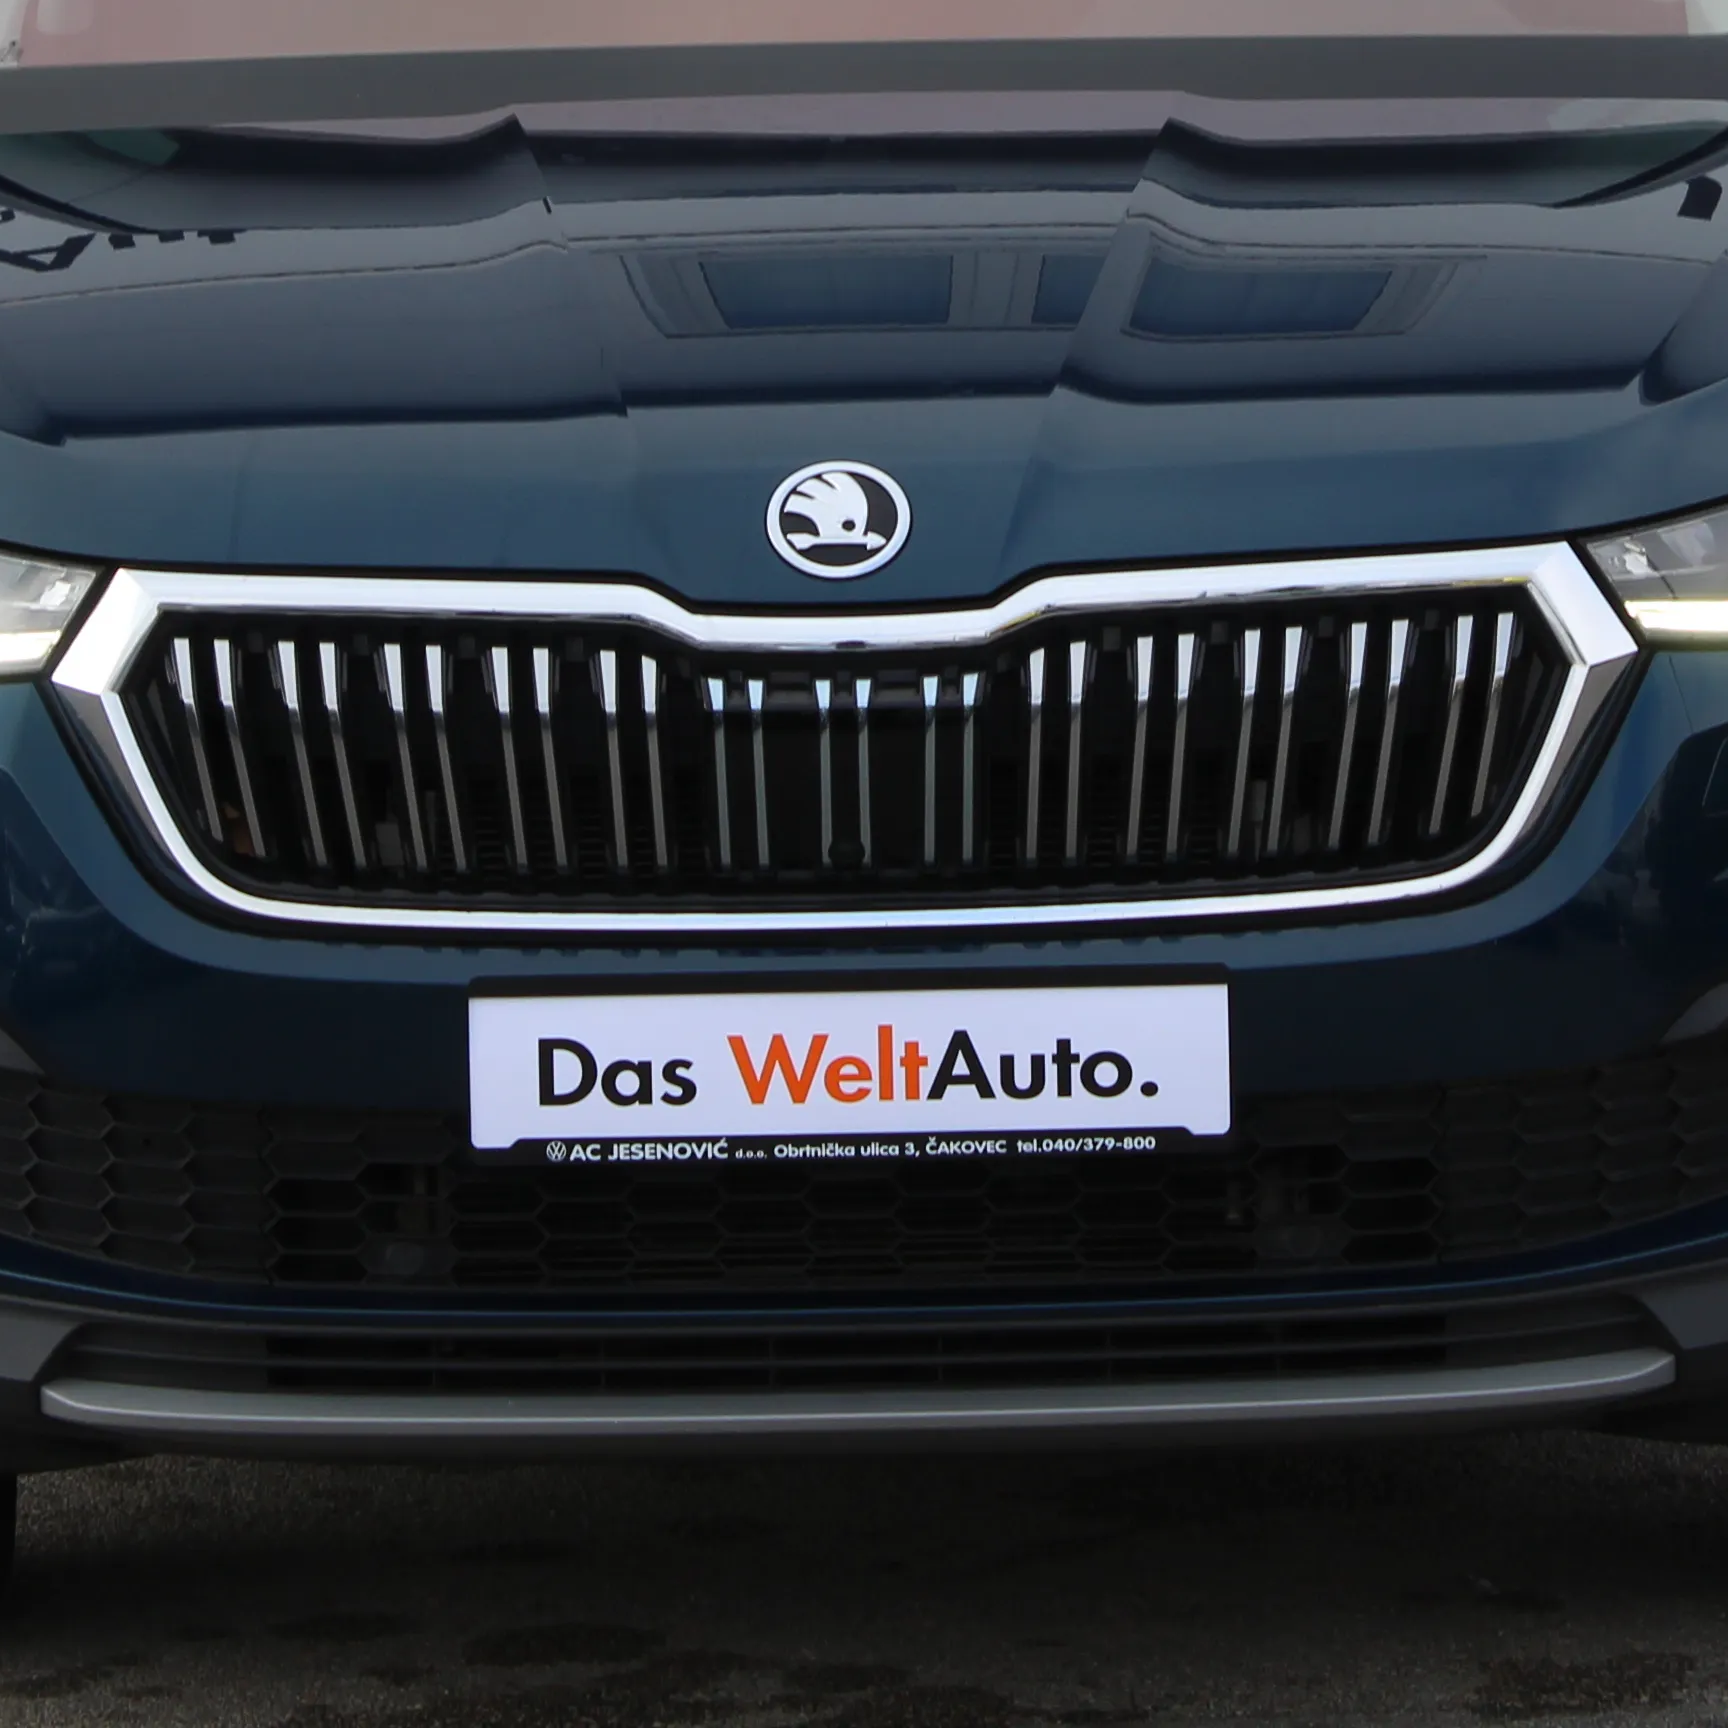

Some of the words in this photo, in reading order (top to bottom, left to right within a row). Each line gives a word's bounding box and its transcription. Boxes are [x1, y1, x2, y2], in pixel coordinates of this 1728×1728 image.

[537, 1037, 698, 1107] Das
[727, 1024, 1159, 1105] WeltAuto.
[570, 1144, 602, 1161] AC
[608, 1137, 728, 1160] JESENOVIĆ
[774, 1143, 855, 1158] Obrtnička
[860, 1142, 900, 1157] ulica
[925, 1136, 1007, 1155] ČAKOVEC
